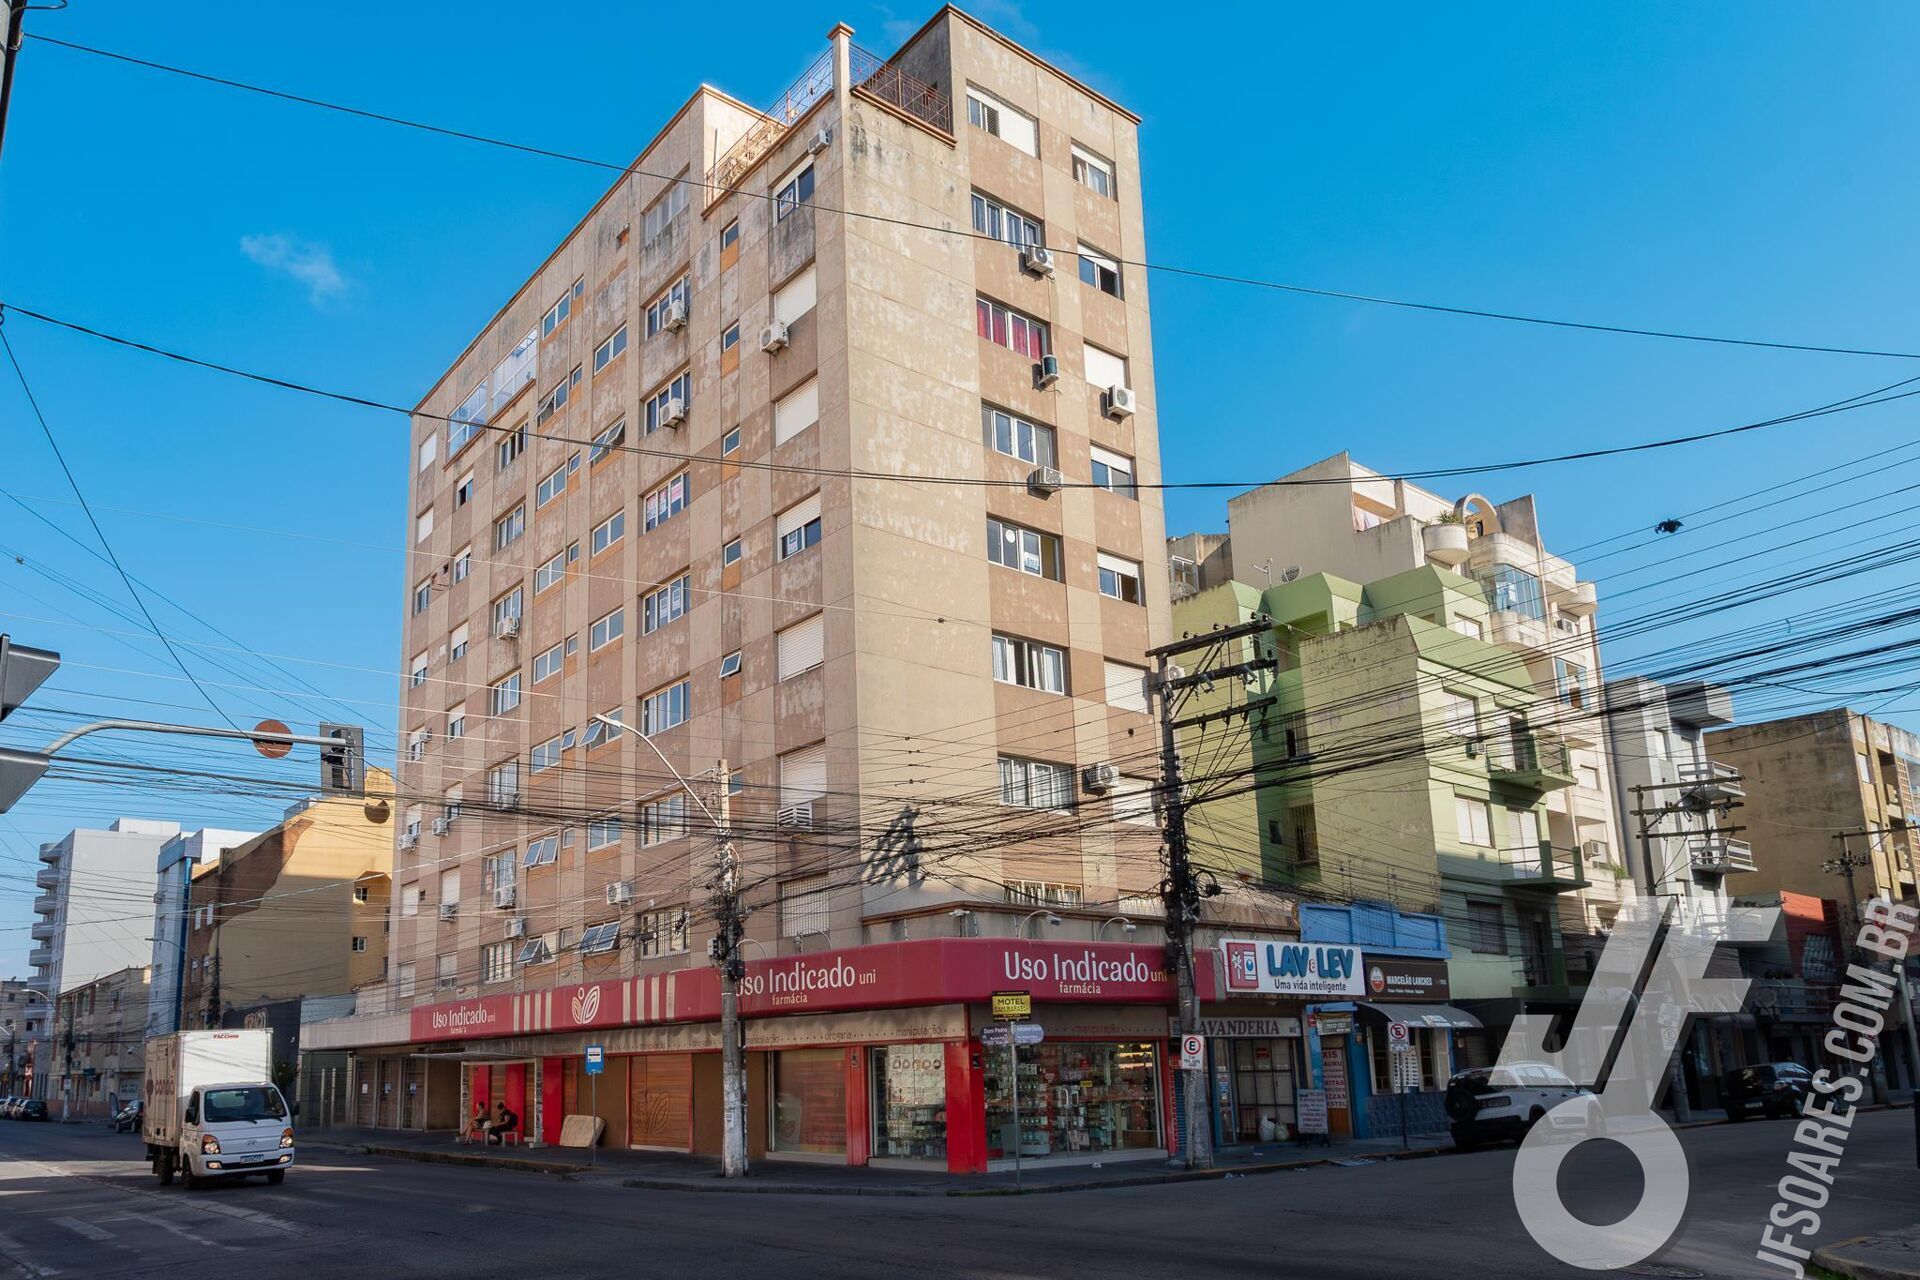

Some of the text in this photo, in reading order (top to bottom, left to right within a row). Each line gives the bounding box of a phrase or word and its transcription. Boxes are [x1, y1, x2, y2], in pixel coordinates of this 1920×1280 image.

[1004, 950, 1167, 983] Uso Indicado uni
[769, 956, 856, 994] Indicado
[859, 969, 876, 985] uni
[1059, 981, 1101, 994] farmácia
[1274, 978, 1347, 993] Uma vida inteligente
[772, 993, 808, 1005] farmácia
[996, 997, 1026, 1006] MOTEL
[432, 1010, 448, 1028] Uso
[449, 1003, 487, 1027] Indicado
[895, 1024, 942, 1037] manipulação
[1200, 1019, 1280, 1036] AVANDERIA
[1188, 1040, 1197, 1051] E
